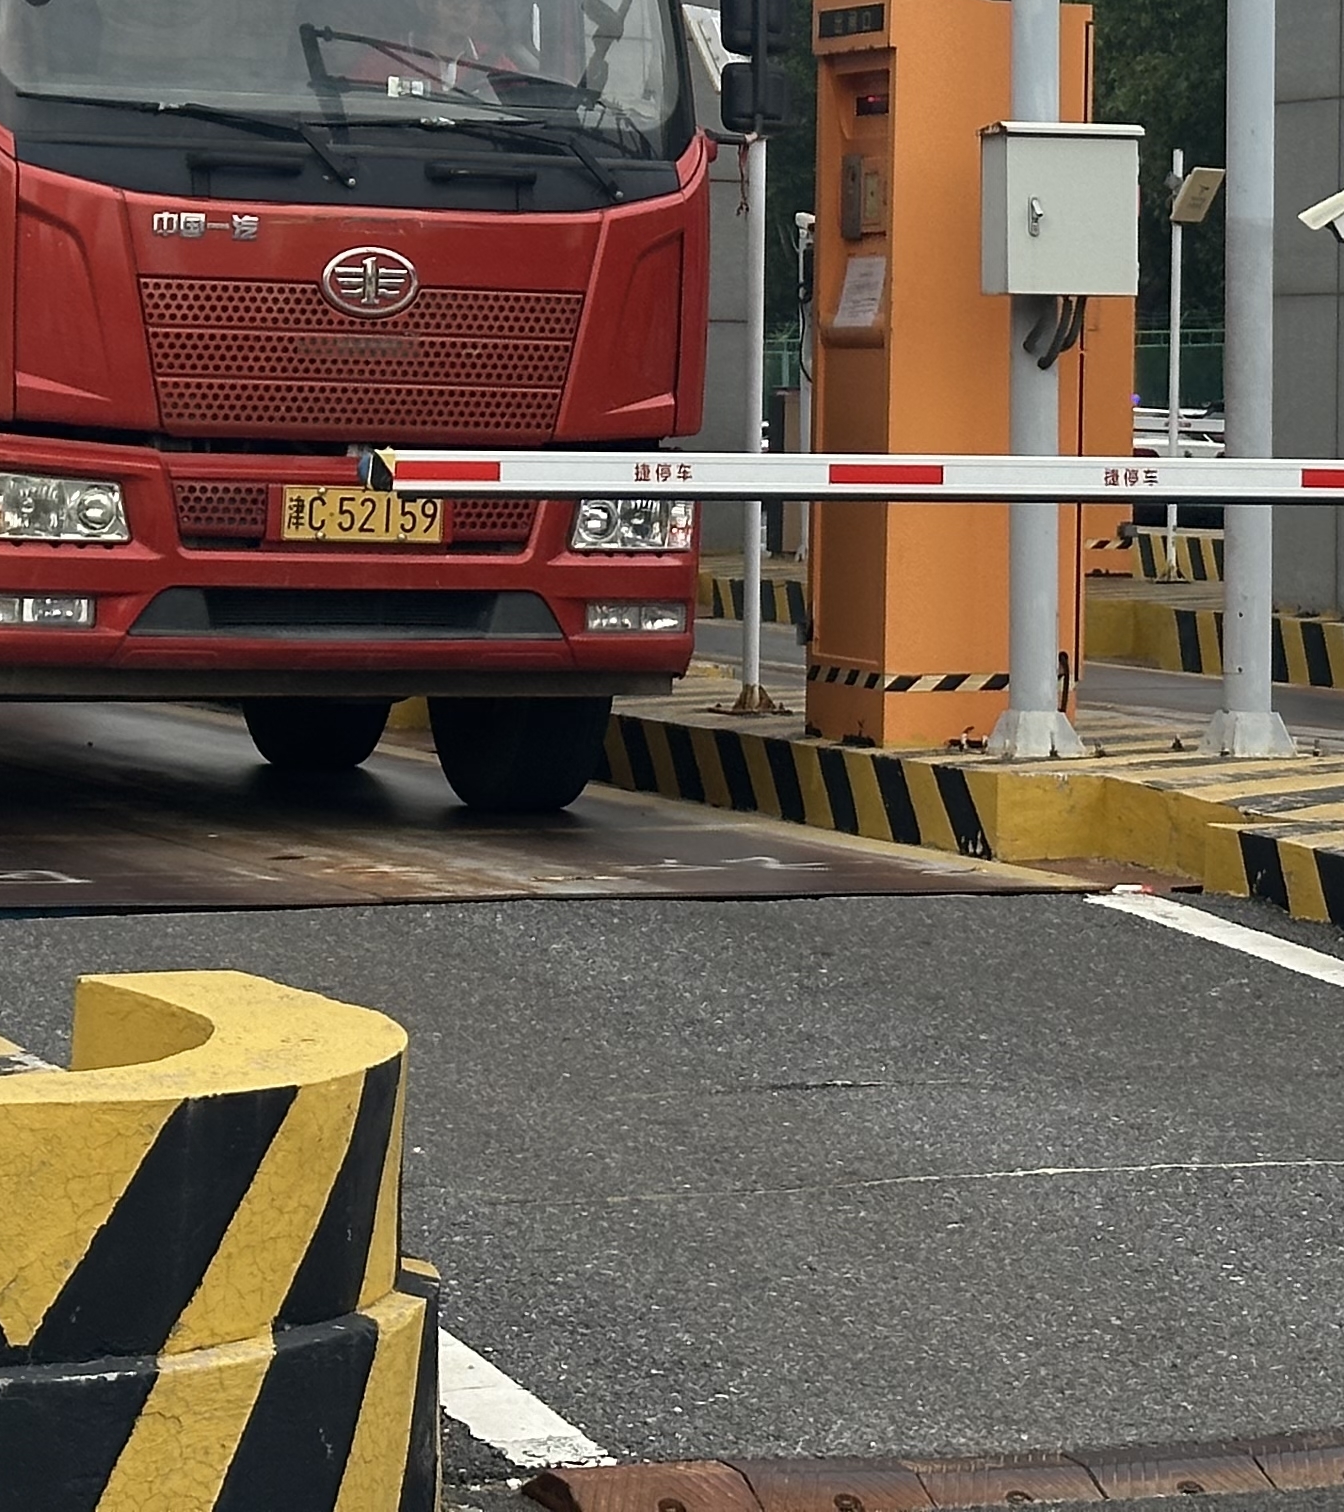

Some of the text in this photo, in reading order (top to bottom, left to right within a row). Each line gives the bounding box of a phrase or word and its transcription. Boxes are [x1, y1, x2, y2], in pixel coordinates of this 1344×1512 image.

[153, 211, 259, 240] 中国一汽
[634, 463, 693, 482] 捷停车
